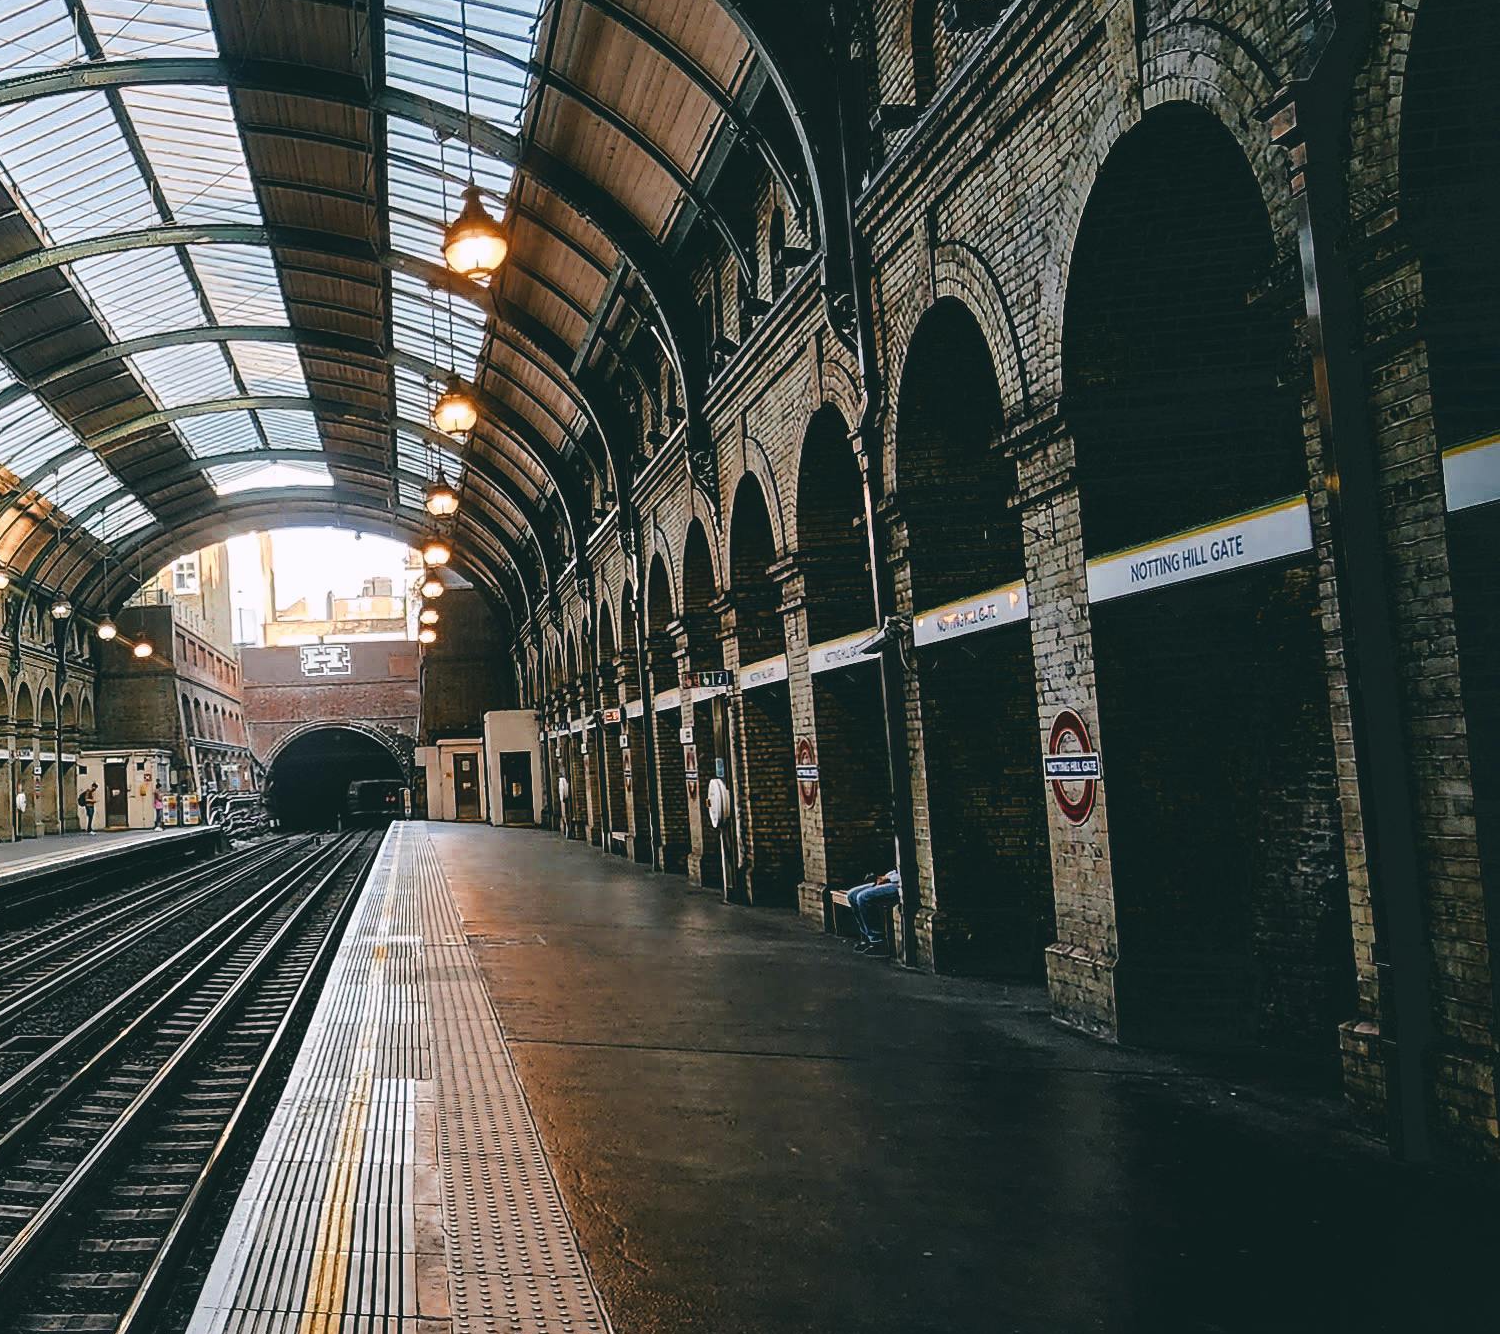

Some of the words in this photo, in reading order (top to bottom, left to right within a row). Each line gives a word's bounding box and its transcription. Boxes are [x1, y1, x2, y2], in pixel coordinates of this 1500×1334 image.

[1130, 553, 1180, 583] NOTTING
[1182, 546, 1208, 570] HILL
[1210, 534, 1244, 561] GATE
